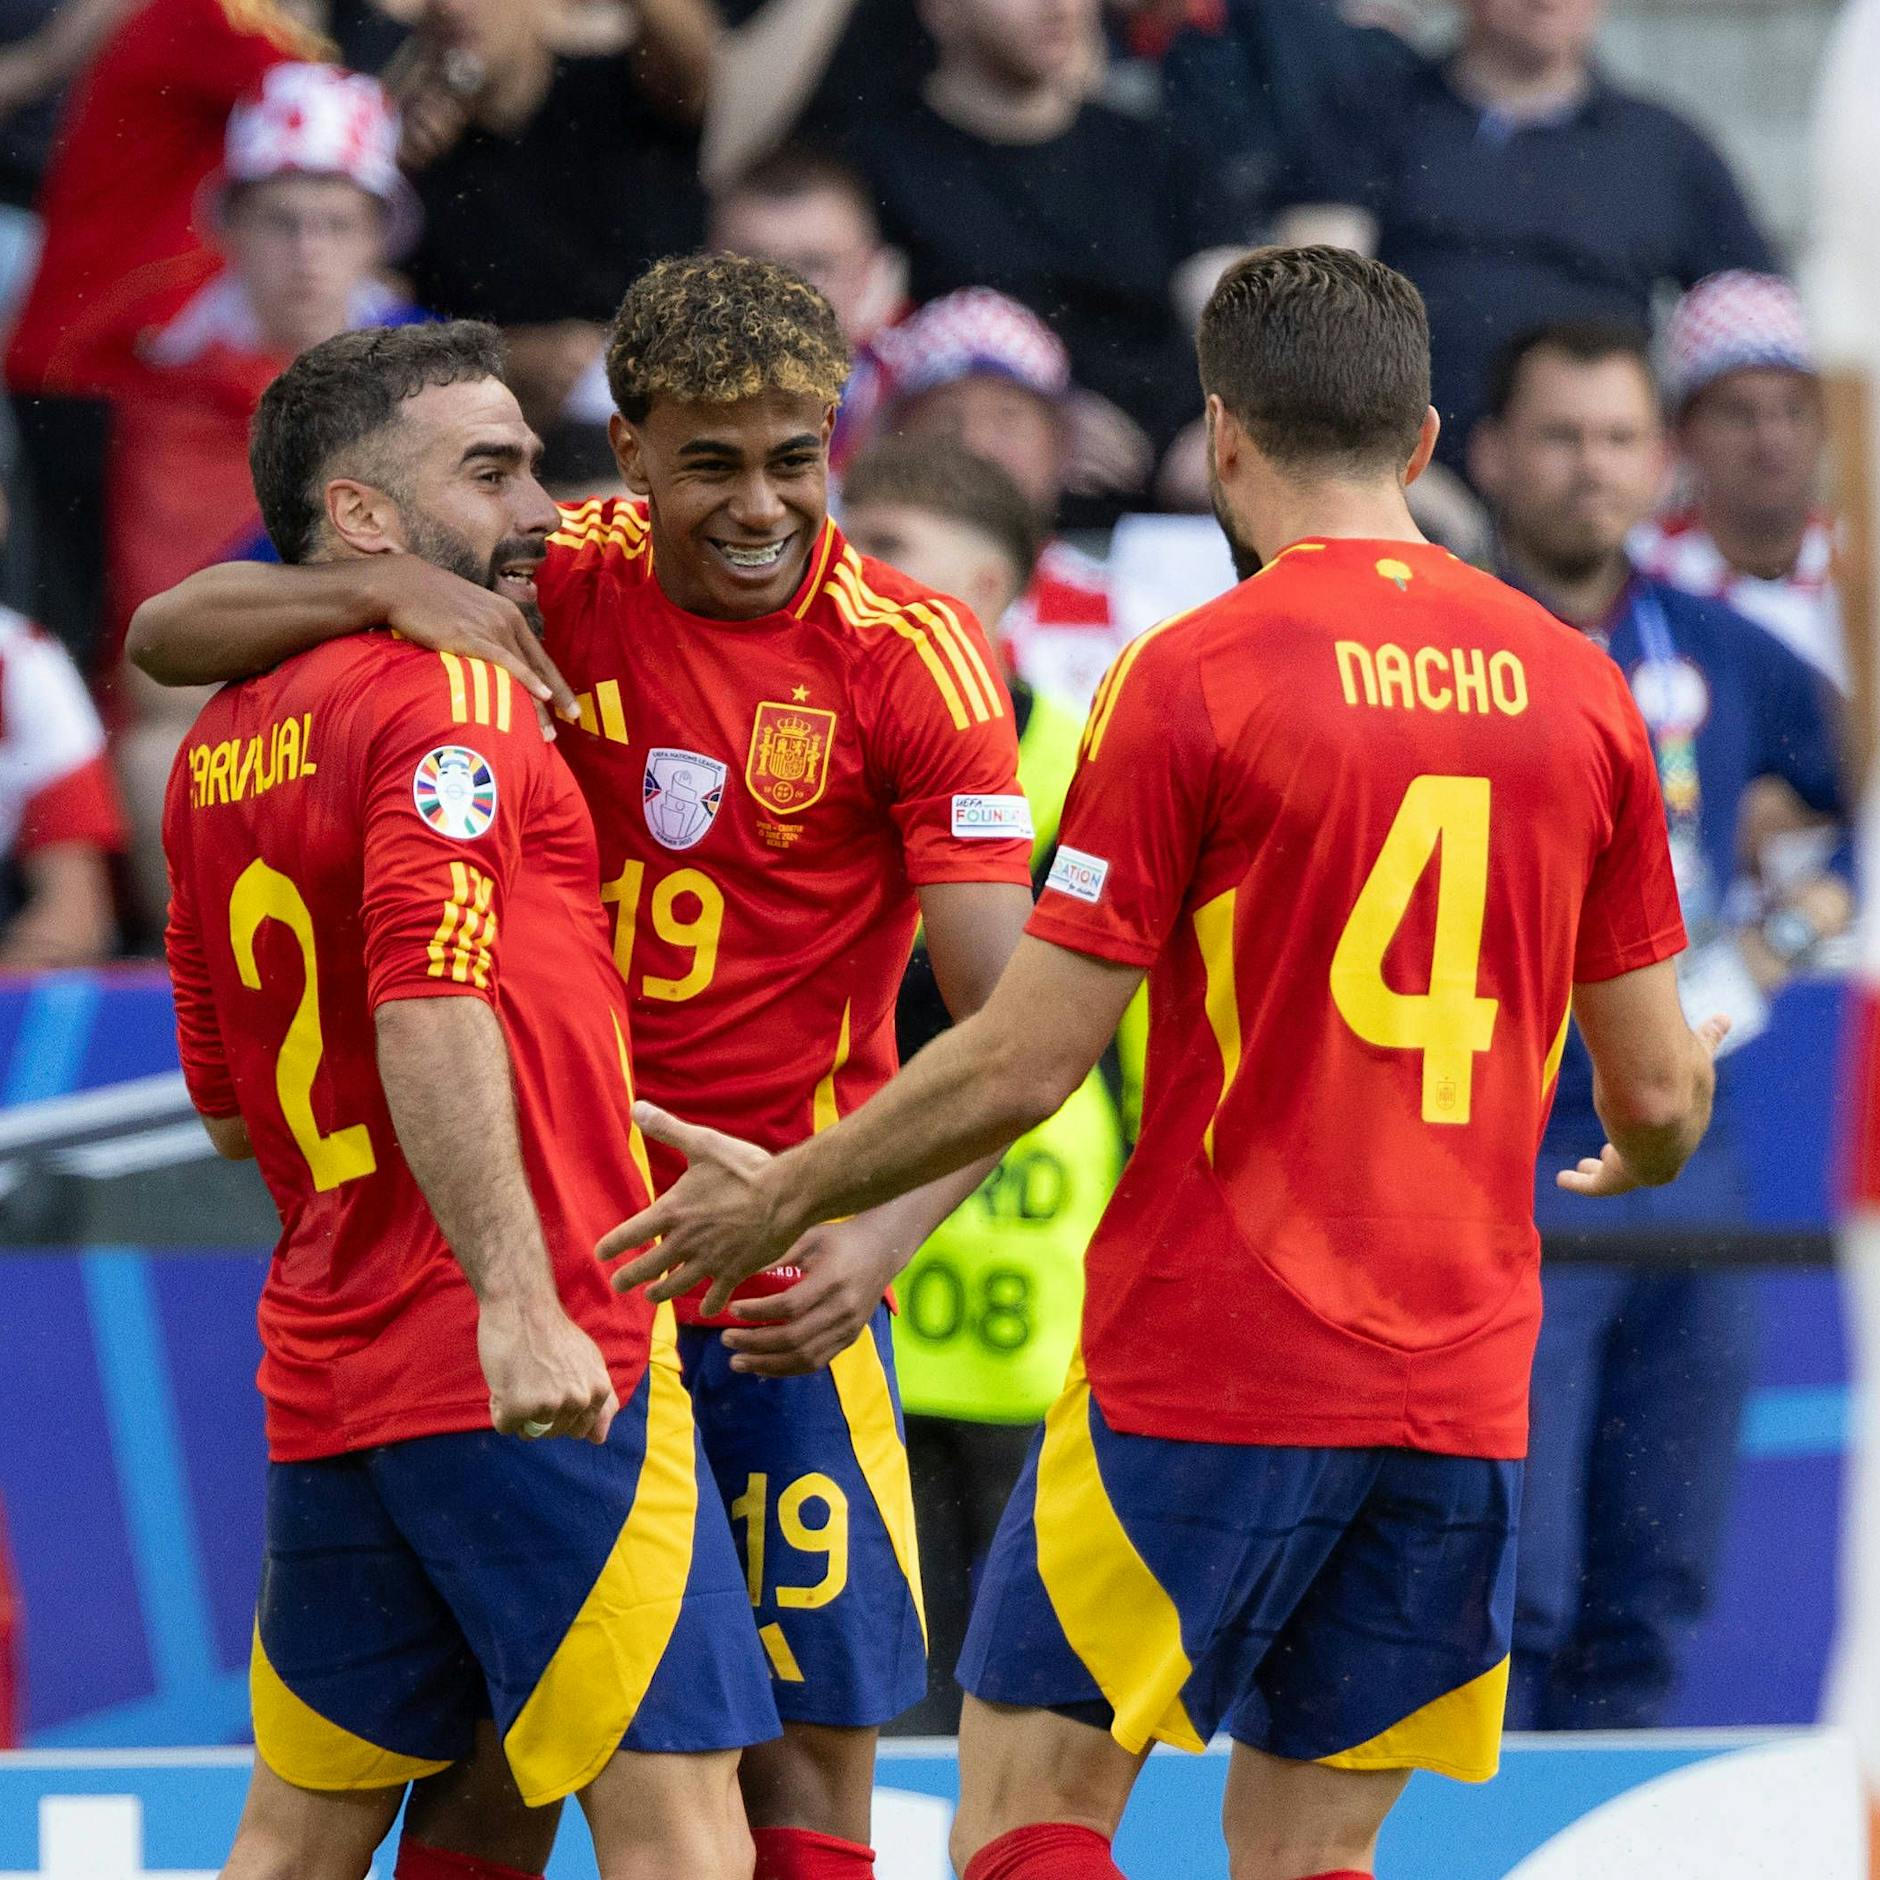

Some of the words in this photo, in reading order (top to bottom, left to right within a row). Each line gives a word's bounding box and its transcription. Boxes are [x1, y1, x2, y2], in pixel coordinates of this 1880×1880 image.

[1335, 641, 1529, 716] NACHO
[189, 713, 317, 810] ARVAJAL
[601, 859, 725, 1002] 19
[1329, 774, 1499, 1124] 4
[229, 857, 377, 1193] 2
[908, 1258, 1031, 1355] 08
[731, 1472, 848, 1609] 19
